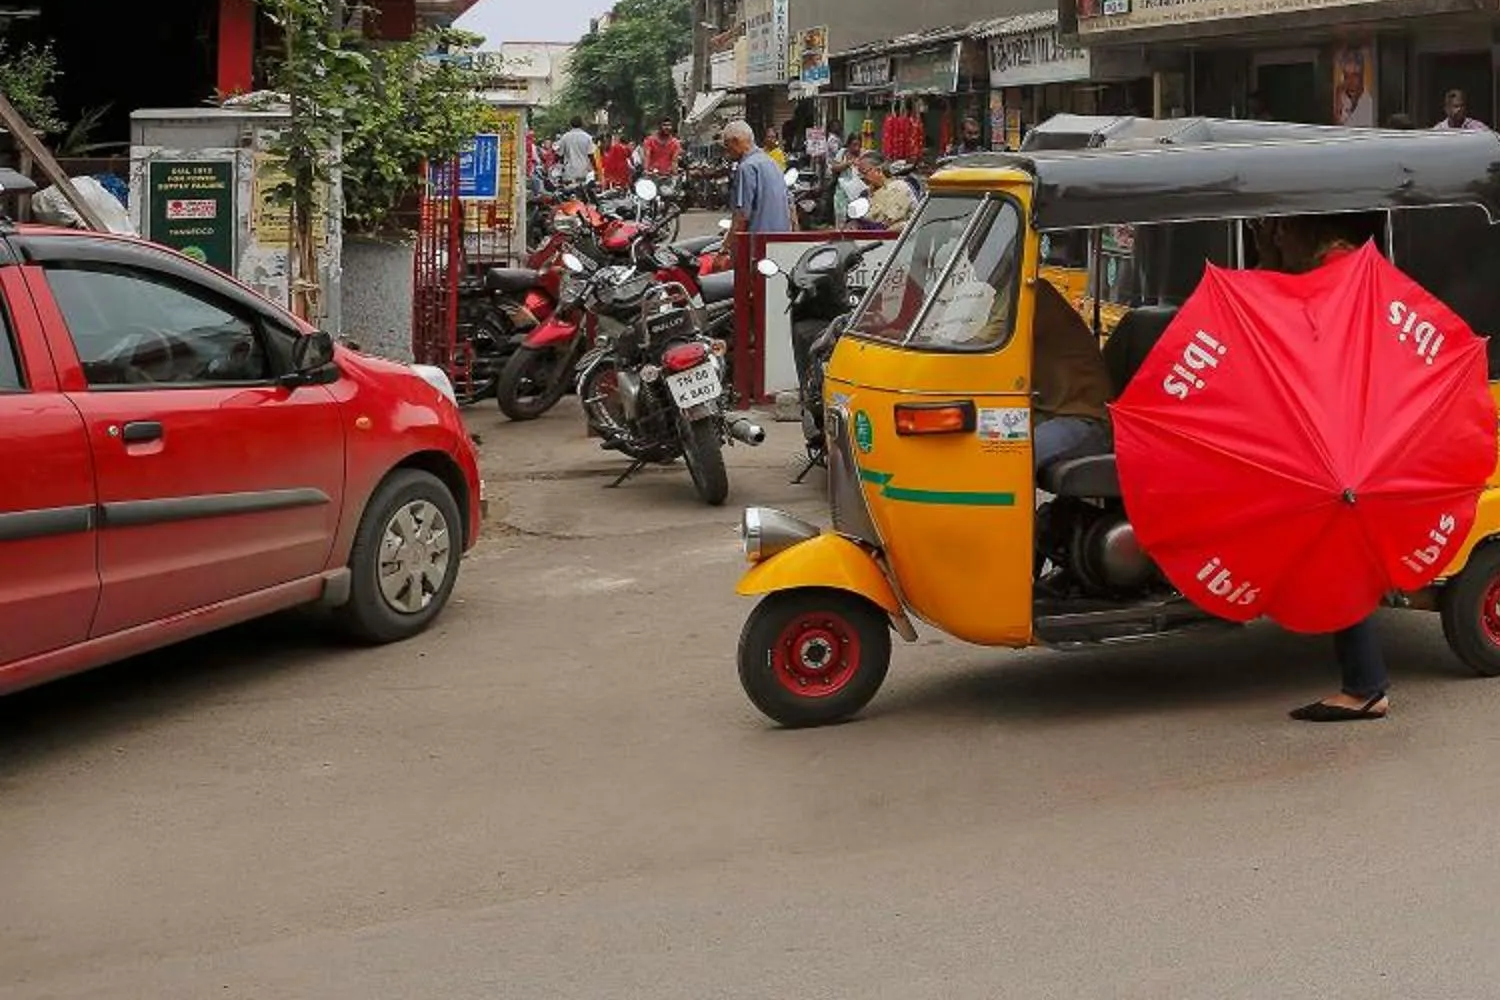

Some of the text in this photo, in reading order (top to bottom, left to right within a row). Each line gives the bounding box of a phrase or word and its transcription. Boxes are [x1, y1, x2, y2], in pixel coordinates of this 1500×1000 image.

[1388, 300, 1445, 365] ibis
[1163, 329, 1228, 400] ibis
[1401, 513, 1455, 574] ibis
[1196, 557, 1261, 605] ibis
